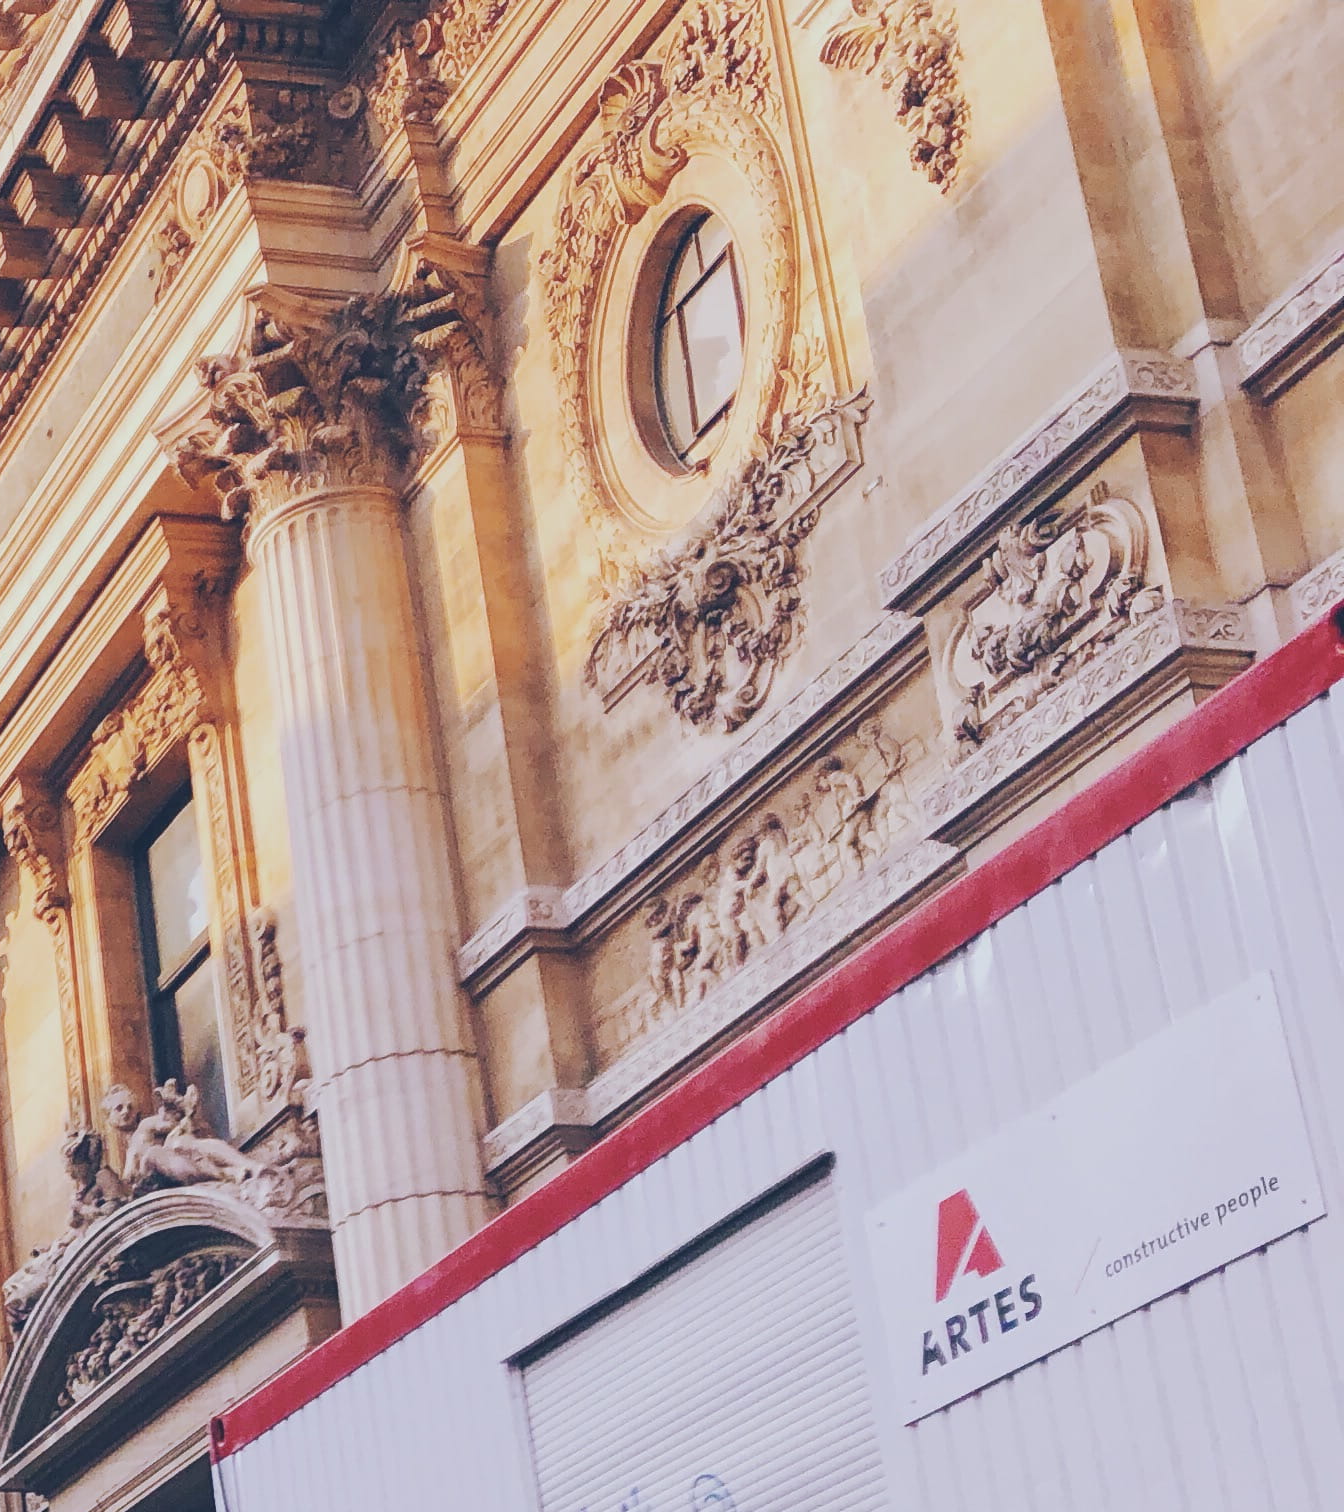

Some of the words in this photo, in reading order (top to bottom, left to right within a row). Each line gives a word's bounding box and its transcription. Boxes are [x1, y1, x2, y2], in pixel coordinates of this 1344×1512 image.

[1105, 1210, 1211, 1278] constructive
[1214, 1175, 1281, 1225] people
[921, 1273, 1044, 1376] ARTES
